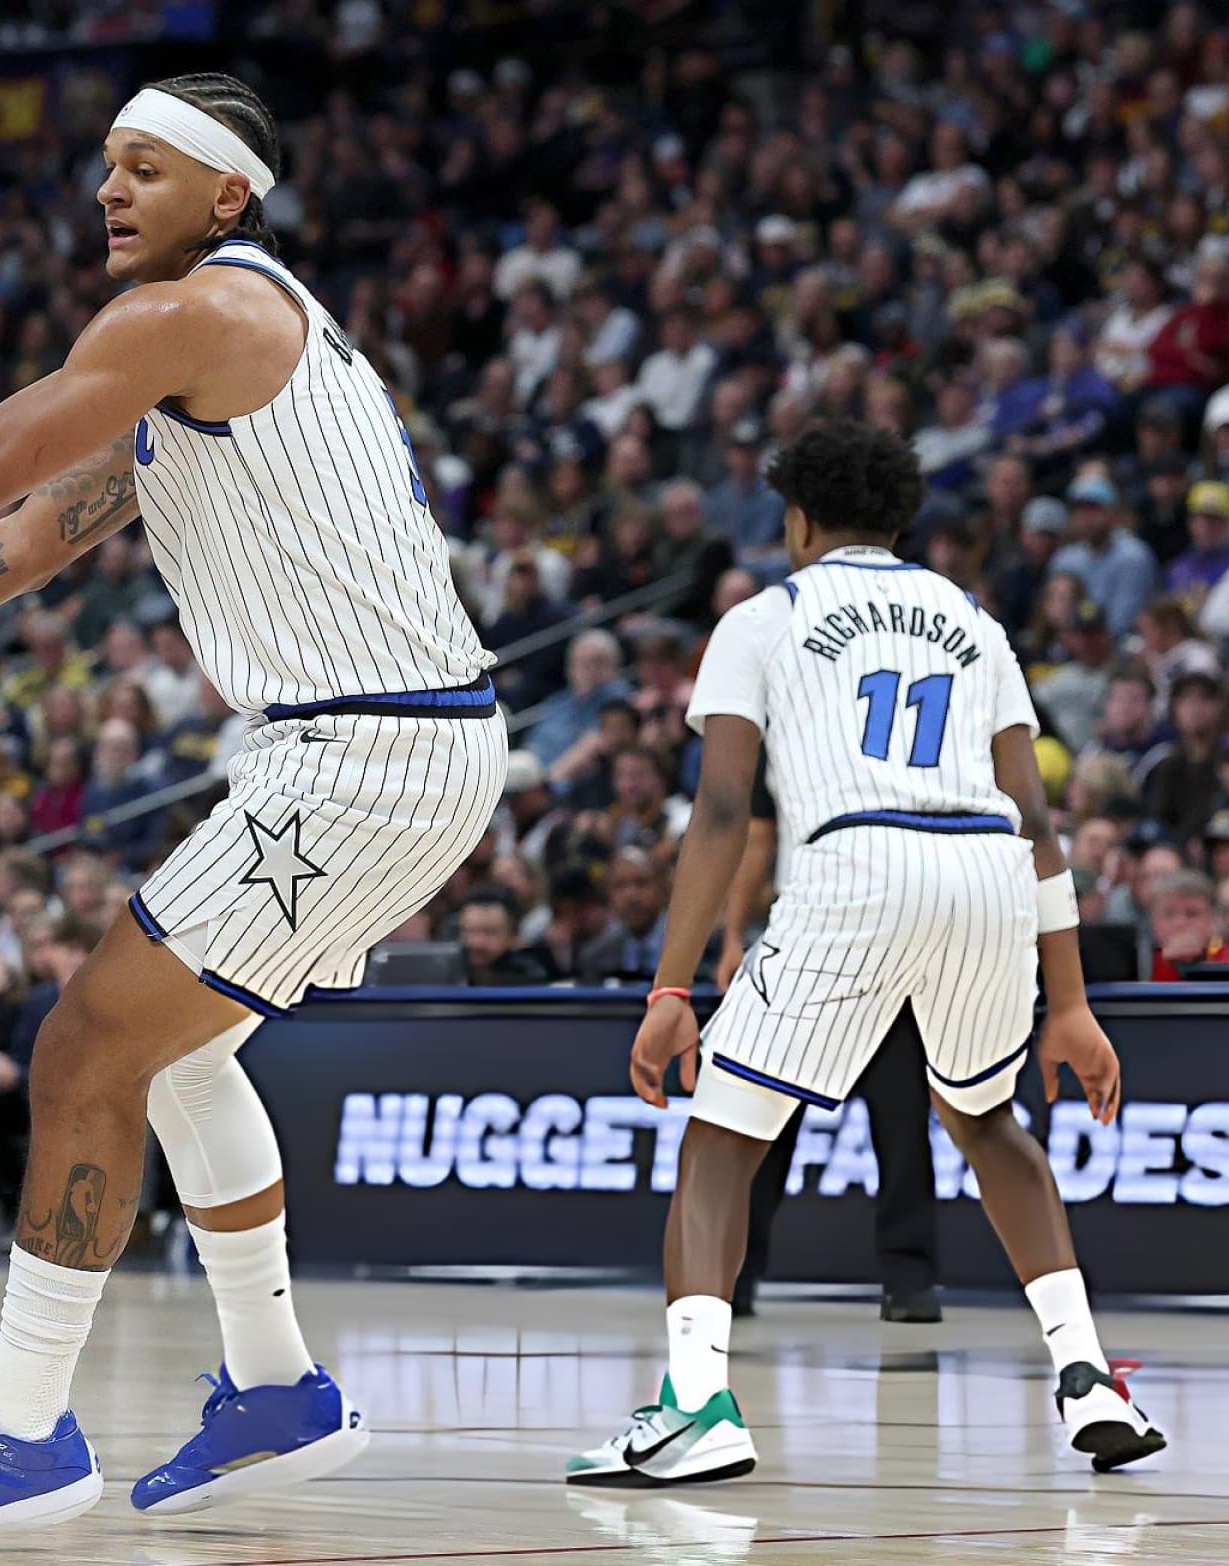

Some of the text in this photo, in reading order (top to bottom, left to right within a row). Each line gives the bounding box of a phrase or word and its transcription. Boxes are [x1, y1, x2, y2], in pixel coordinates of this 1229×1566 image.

[802, 601, 982, 669] RICHARDSON
[857, 669, 955, 768] 11
[334, 1092, 694, 1193] NUGGET
